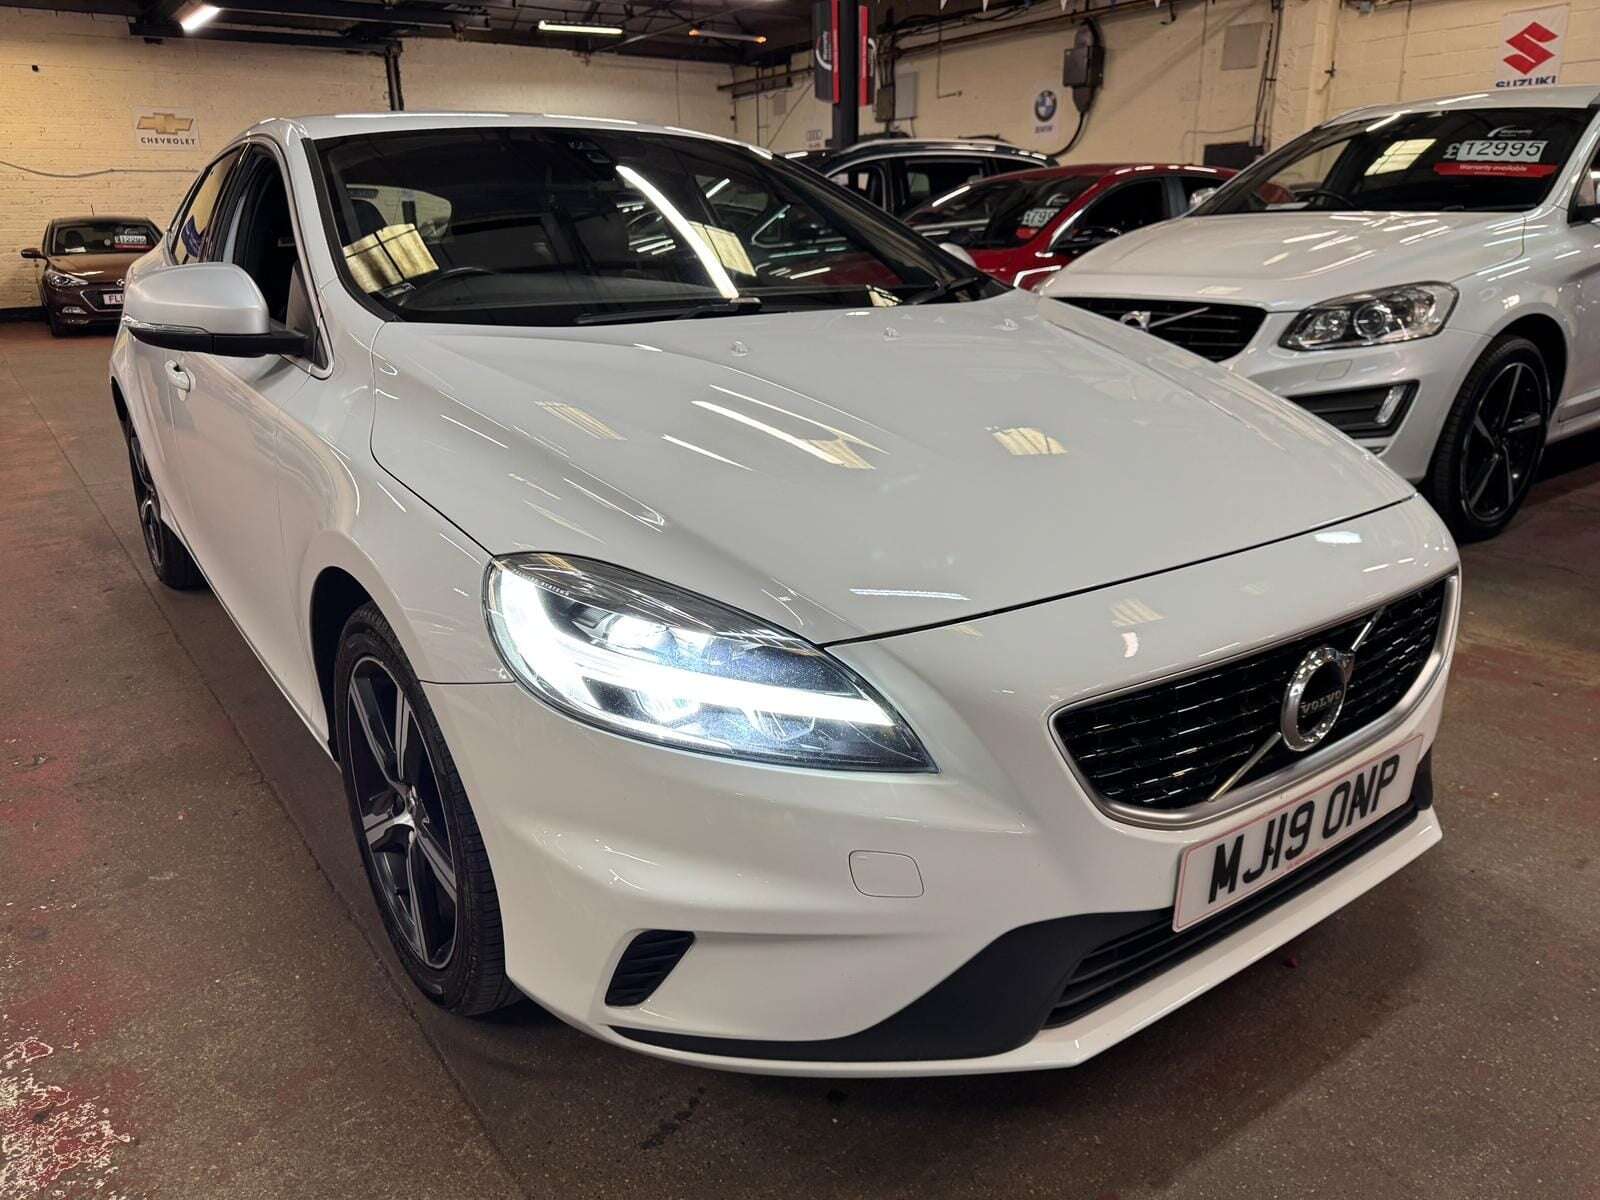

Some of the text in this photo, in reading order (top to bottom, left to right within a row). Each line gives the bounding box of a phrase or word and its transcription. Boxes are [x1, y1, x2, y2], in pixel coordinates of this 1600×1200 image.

[140, 136, 195, 145] CHEVROLET
[1301, 690, 1343, 713] VOLVO
[1208, 754, 1400, 904] MJ19 ONP
